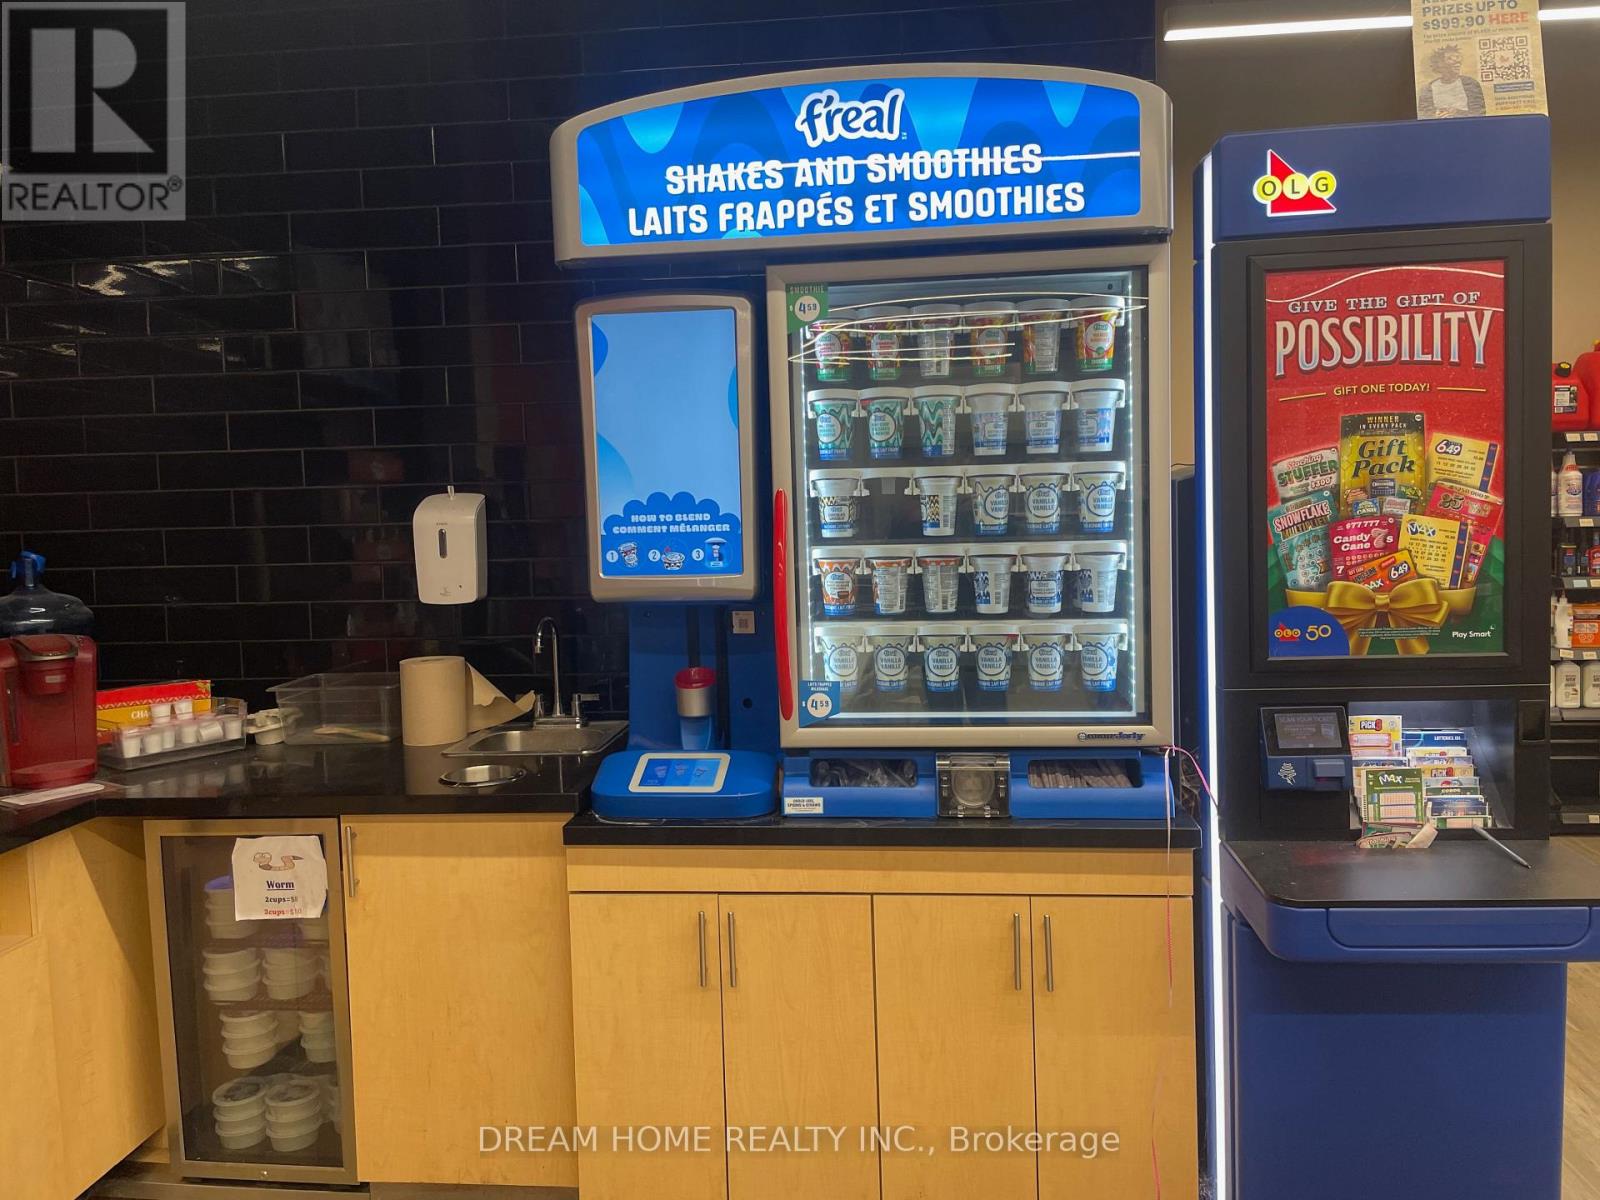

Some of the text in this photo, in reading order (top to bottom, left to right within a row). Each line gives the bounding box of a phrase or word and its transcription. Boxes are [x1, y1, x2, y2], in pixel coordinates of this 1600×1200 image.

[1422, 0, 1518, 17] PRIZES UP TO
[1423, 12, 1529, 30] $999.90 HERE
[665, 143, 1043, 195] SHAKES AND SMOOTHIES
[1258, 174, 1332, 200] OLG
[628, 183, 1085, 237] LAITS FRAPPÉS ET SMOOTHIES
[1288, 292, 1481, 314] GIVE THE GIFT OF
[1276, 310, 1493, 376] POSSIBILITY
[1333, 382, 1431, 396] GIFT ONE TODAY!
[1358, 439, 1408, 459] Gift
[1278, 460, 1338, 486] STUFFER
[1352, 456, 1415, 478] Pack
[631, 513, 711, 522] HOW TO BLEND
[1274, 501, 1330, 532] SNOWFLAKE
[612, 523, 731, 534] COMMENT MÉLANGER
[1333, 533, 1371, 544] Candy
[1341, 542, 1371, 551] Cane
[1306, 625, 1332, 641] 50
[1452, 629, 1492, 639] Play Smart
[1379, 774, 1402, 785] MAX
[266, 881, 294, 889] Worm
